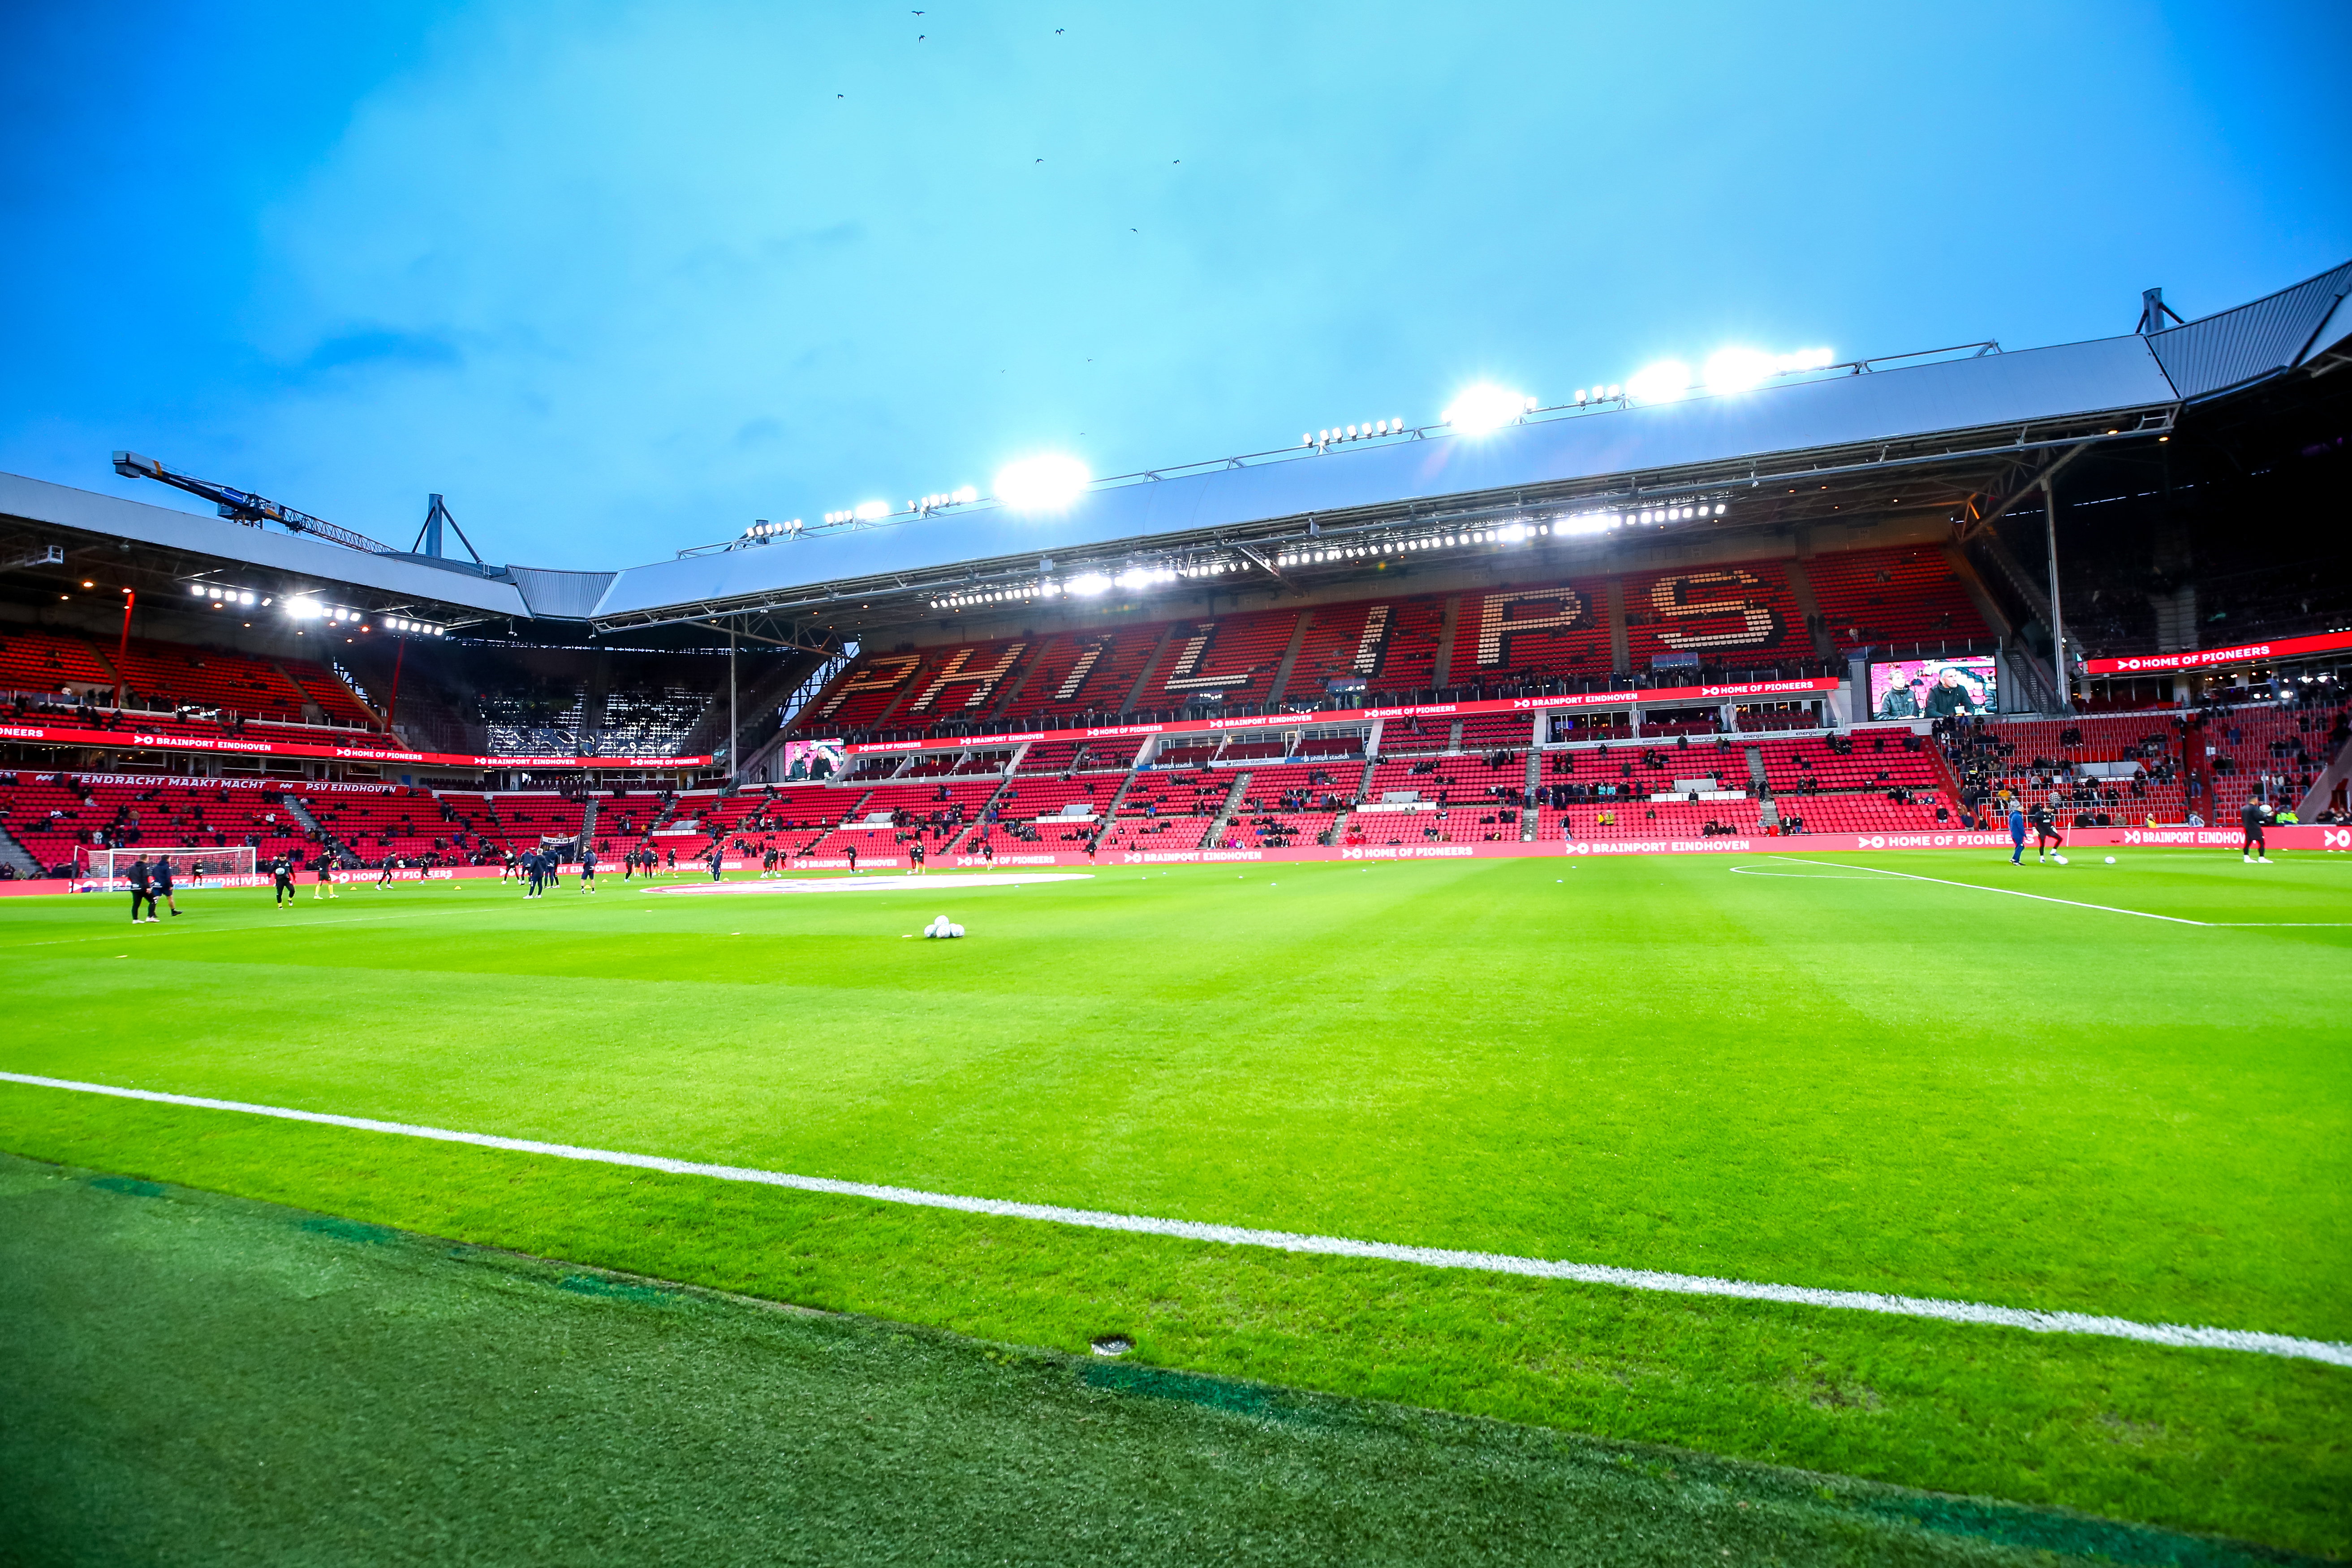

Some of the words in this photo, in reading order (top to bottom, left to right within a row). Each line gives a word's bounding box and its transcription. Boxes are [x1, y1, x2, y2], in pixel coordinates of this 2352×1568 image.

[810, 569, 1773, 717] PHILIPS
[2143, 658, 2179, 667] HOME
[2182, 655, 2198, 664] OF
[2202, 646, 2269, 663] PIONEERS
[1721, 686, 1747, 694] HOME
[1765, 681, 1813, 691] PIONEERS
[1532, 697, 1582, 706] BRAINPORT
[1586, 693, 1637, 702] EINDHOVEN
[1416, 705, 1456, 714] PIONEERS
[1225, 718, 1266, 726] BRAINPORT
[1269, 715, 1312, 724] EINDHOVEN
[1008, 733, 1044, 741] EINDHOVEN
[157, 738, 214, 747] BRAINPORT
[218, 741, 271, 750] EINDHOVEN
[168, 778, 218, 787] MAAKT
[220, 780, 266, 789] MACHT
[1889, 836, 1930, 846] HOME
[1934, 835, 1953, 845] OF
[1958, 834, 2034, 845] PIONEES
[2143, 832, 2194, 843] BRAINPORT
[2198, 832, 2256, 844] EINDHOV
[1365, 849, 1396, 857] HOME
[1399, 848, 1413, 857] OF
[1416, 847, 1473, 856] PIONEERS
[1593, 842, 1667, 853] BRAINPORT
[1671, 840, 1749, 851] EINDHOVEN
[1012, 856, 1055, 864] PIONEERS
[1144, 853, 1200, 862] BRAINPORT
[1203, 851, 1262, 860] EINDHOVEN
[570, 865, 616, 873] EINOVEN
[353, 872, 383, 880] HOME
[403, 870, 452, 879] PIOEERS
